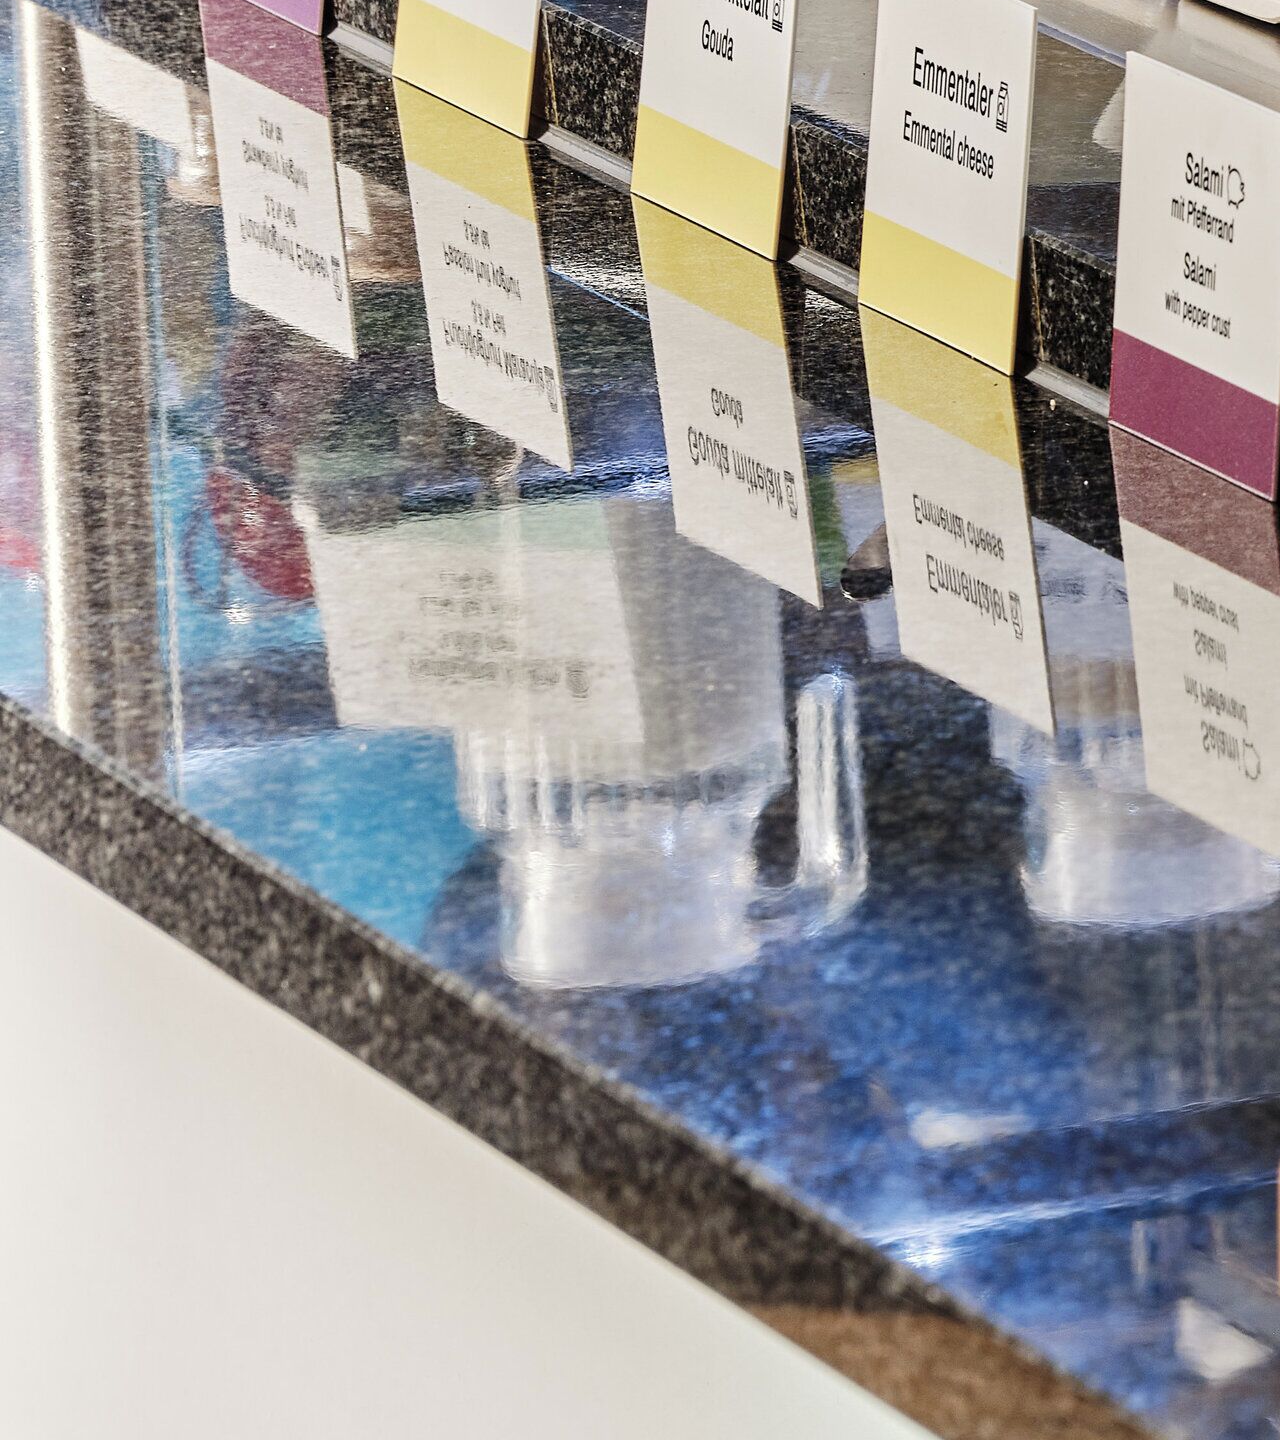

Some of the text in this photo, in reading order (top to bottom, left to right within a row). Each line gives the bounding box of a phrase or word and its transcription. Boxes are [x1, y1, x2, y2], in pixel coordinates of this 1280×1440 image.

[701, 19, 734, 62] Gouda
[912, 46, 994, 118] Emmentaler
[903, 109, 994, 179] Emmental cheese
[1185, 151, 1225, 198] Salami
[1170, 195, 1235, 244] mit Pfefferrand
[1183, 251, 1217, 291] Salami
[1164, 290, 1232, 340] with pepper crust
